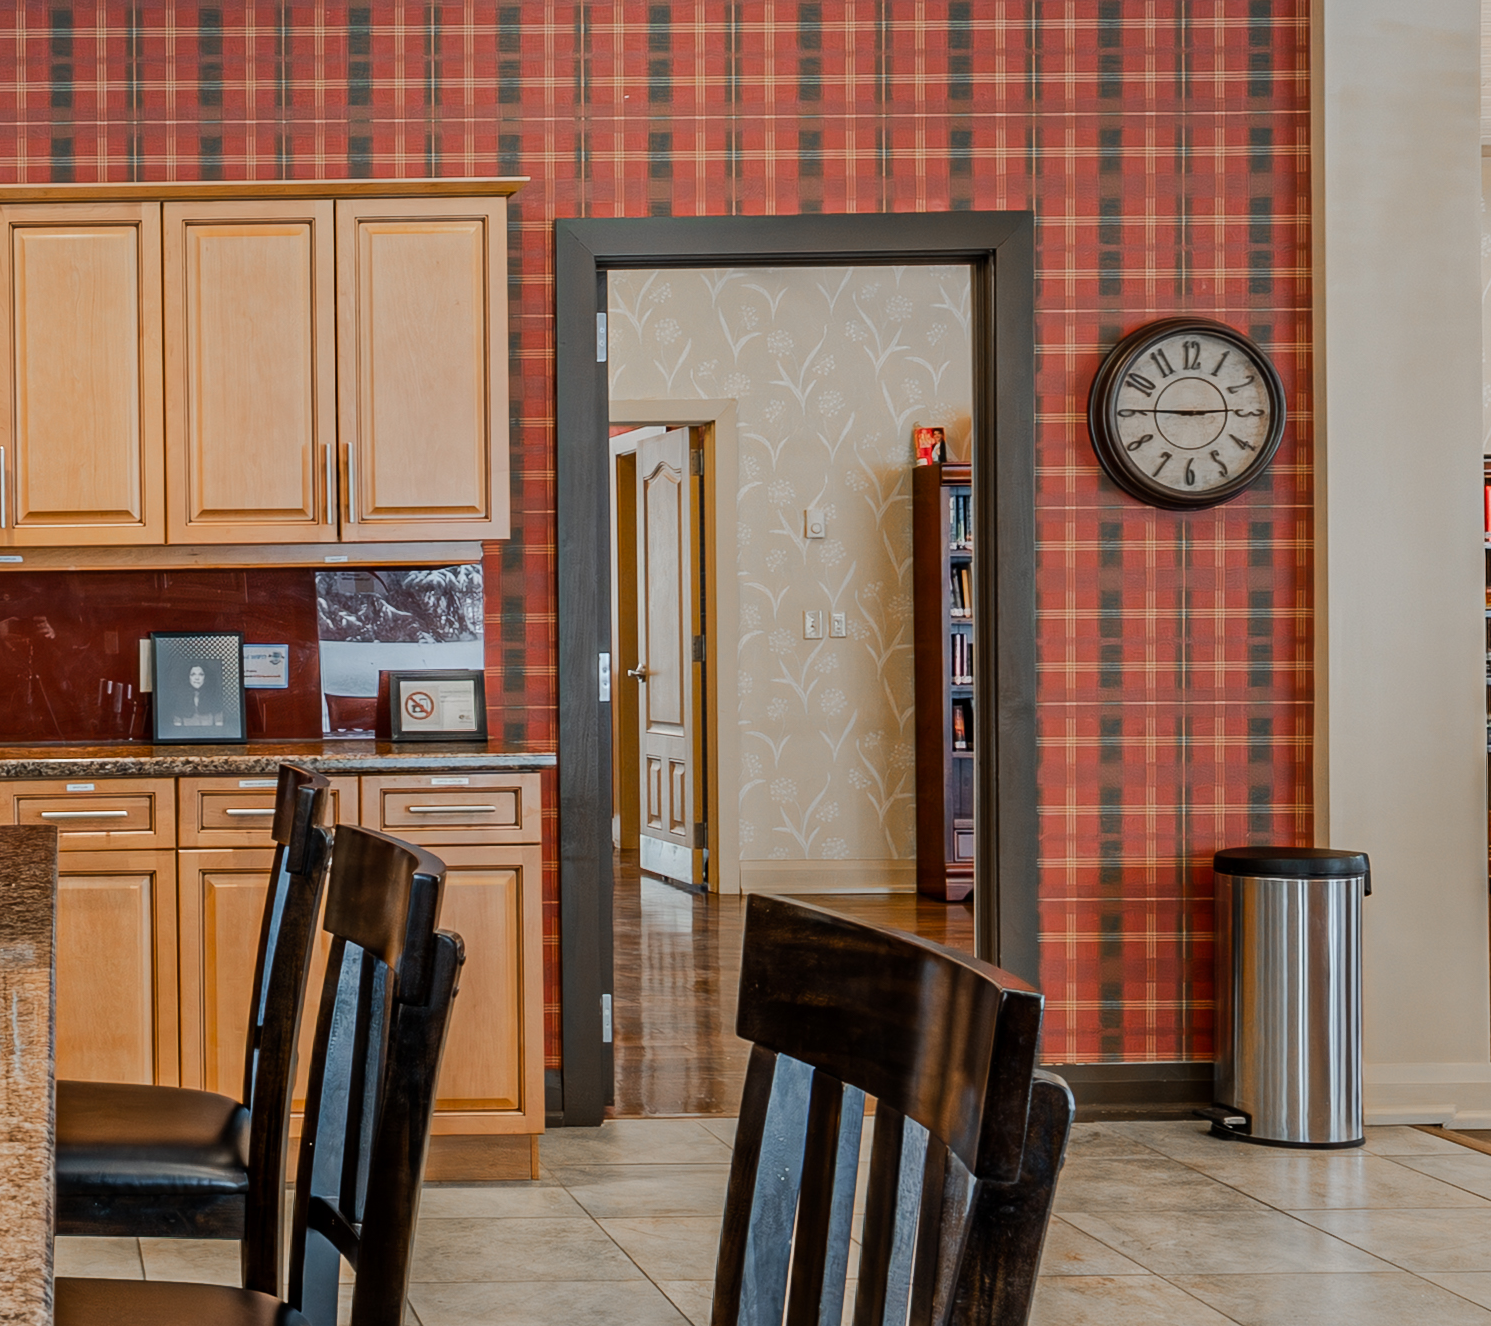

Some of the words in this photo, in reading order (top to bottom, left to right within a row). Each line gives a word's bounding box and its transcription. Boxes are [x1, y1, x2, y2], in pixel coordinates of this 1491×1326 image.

[1150, 348, 1176, 378] 11
[1182, 340, 1201, 370] 12
[1211, 350, 1230, 377] 1
[1125, 373, 1156, 398] 10
[1226, 375, 1255, 394] 2
[1117, 409, 1148, 418] 9
[1234, 409, 1265, 418] 3
[1127, 434, 1154, 451] 8
[1228, 434, 1256, 451] 4
[1152, 451, 1172, 477] 7
[1185, 458, 1195, 486] 6
[1210, 450, 1228, 478] 5
